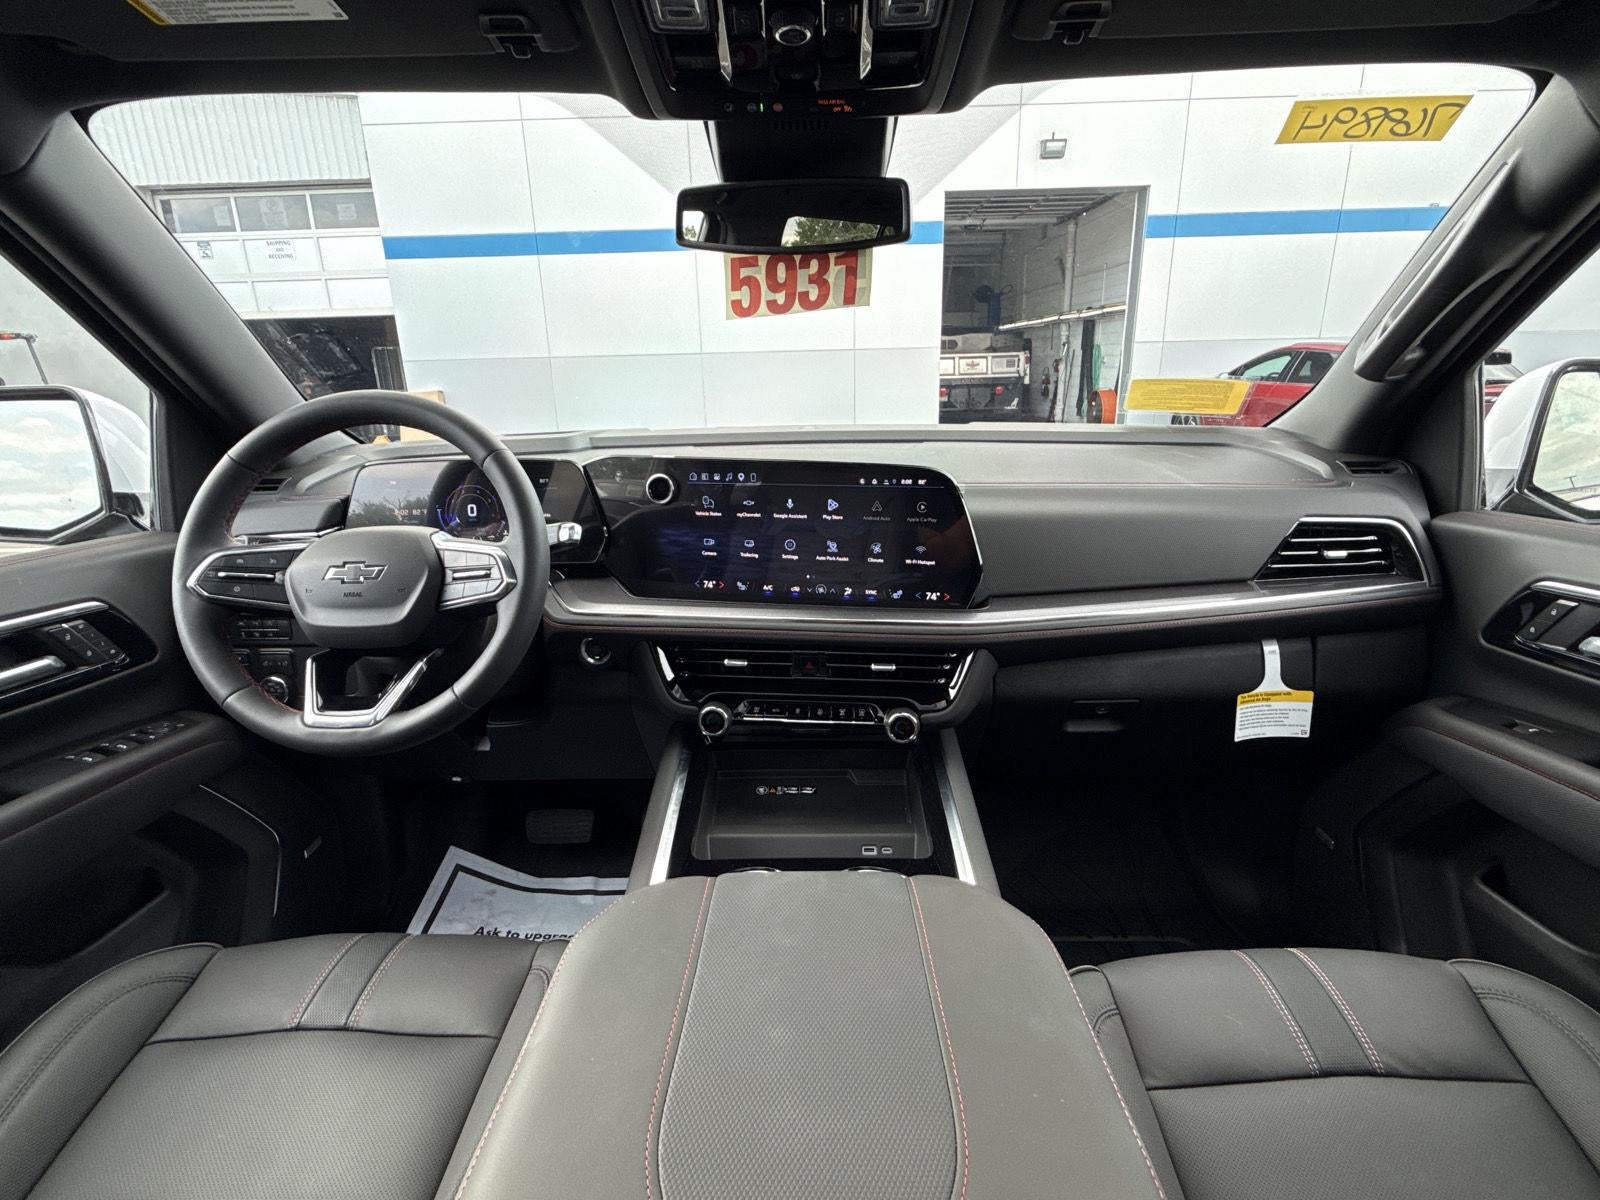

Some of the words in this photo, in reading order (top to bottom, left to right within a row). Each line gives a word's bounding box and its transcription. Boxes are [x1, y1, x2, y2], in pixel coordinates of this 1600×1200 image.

[730, 250, 858, 317] 5931
[467, 504, 477, 517] 0
[474, 926, 502, 937] Ask
[505, 929, 520, 939] to
